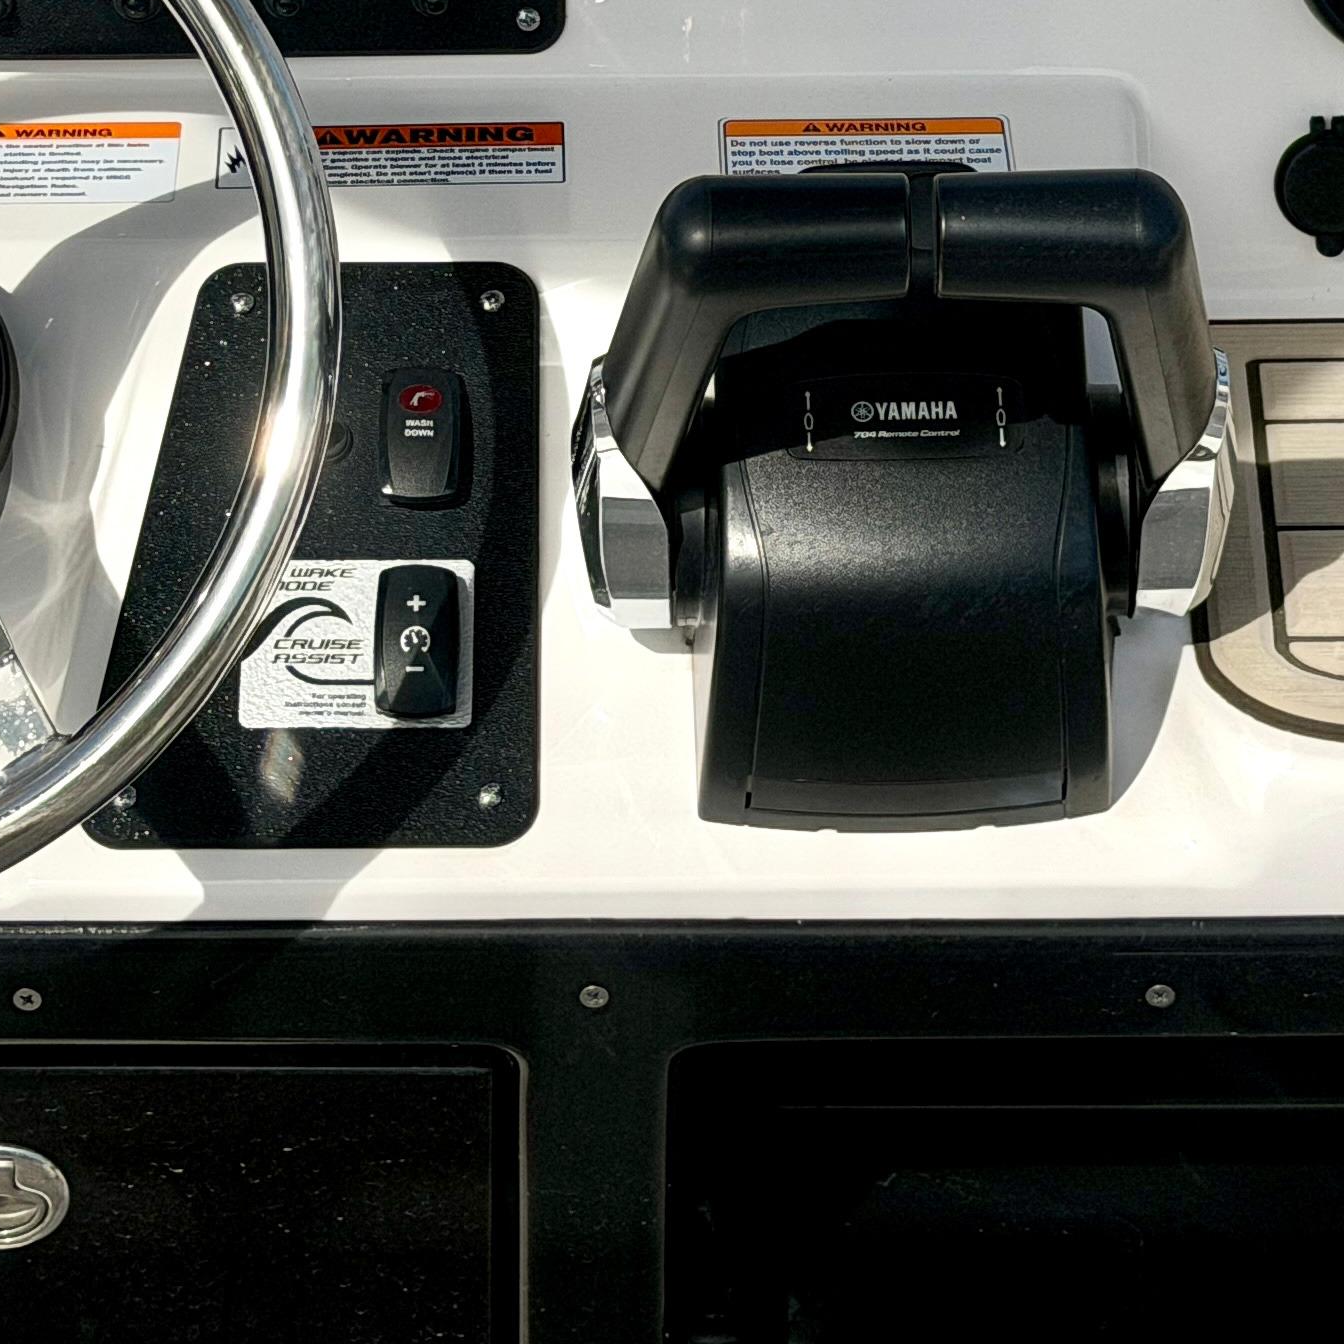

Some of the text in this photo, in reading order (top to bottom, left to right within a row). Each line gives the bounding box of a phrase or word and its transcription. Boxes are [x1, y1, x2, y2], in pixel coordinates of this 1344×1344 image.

[825, 122, 927, 132] WARNING
[15, 127, 112, 138] WARNING
[343, 127, 534, 145] WARNING
[840, 138, 887, 146] function
[731, 149, 756, 157] stop
[869, 148, 904, 156] speed
[875, 401, 958, 420] YAMAHA
[405, 419, 433, 427] WASH
[404, 429, 434, 437] DOWN
[878, 430, 919, 438] Remote
[920, 429, 960, 437] Control
[290, 567, 357, 578] WAKE
[273, 639, 365, 650] CRUISE
[271, 653, 364, 665] ASSIST
